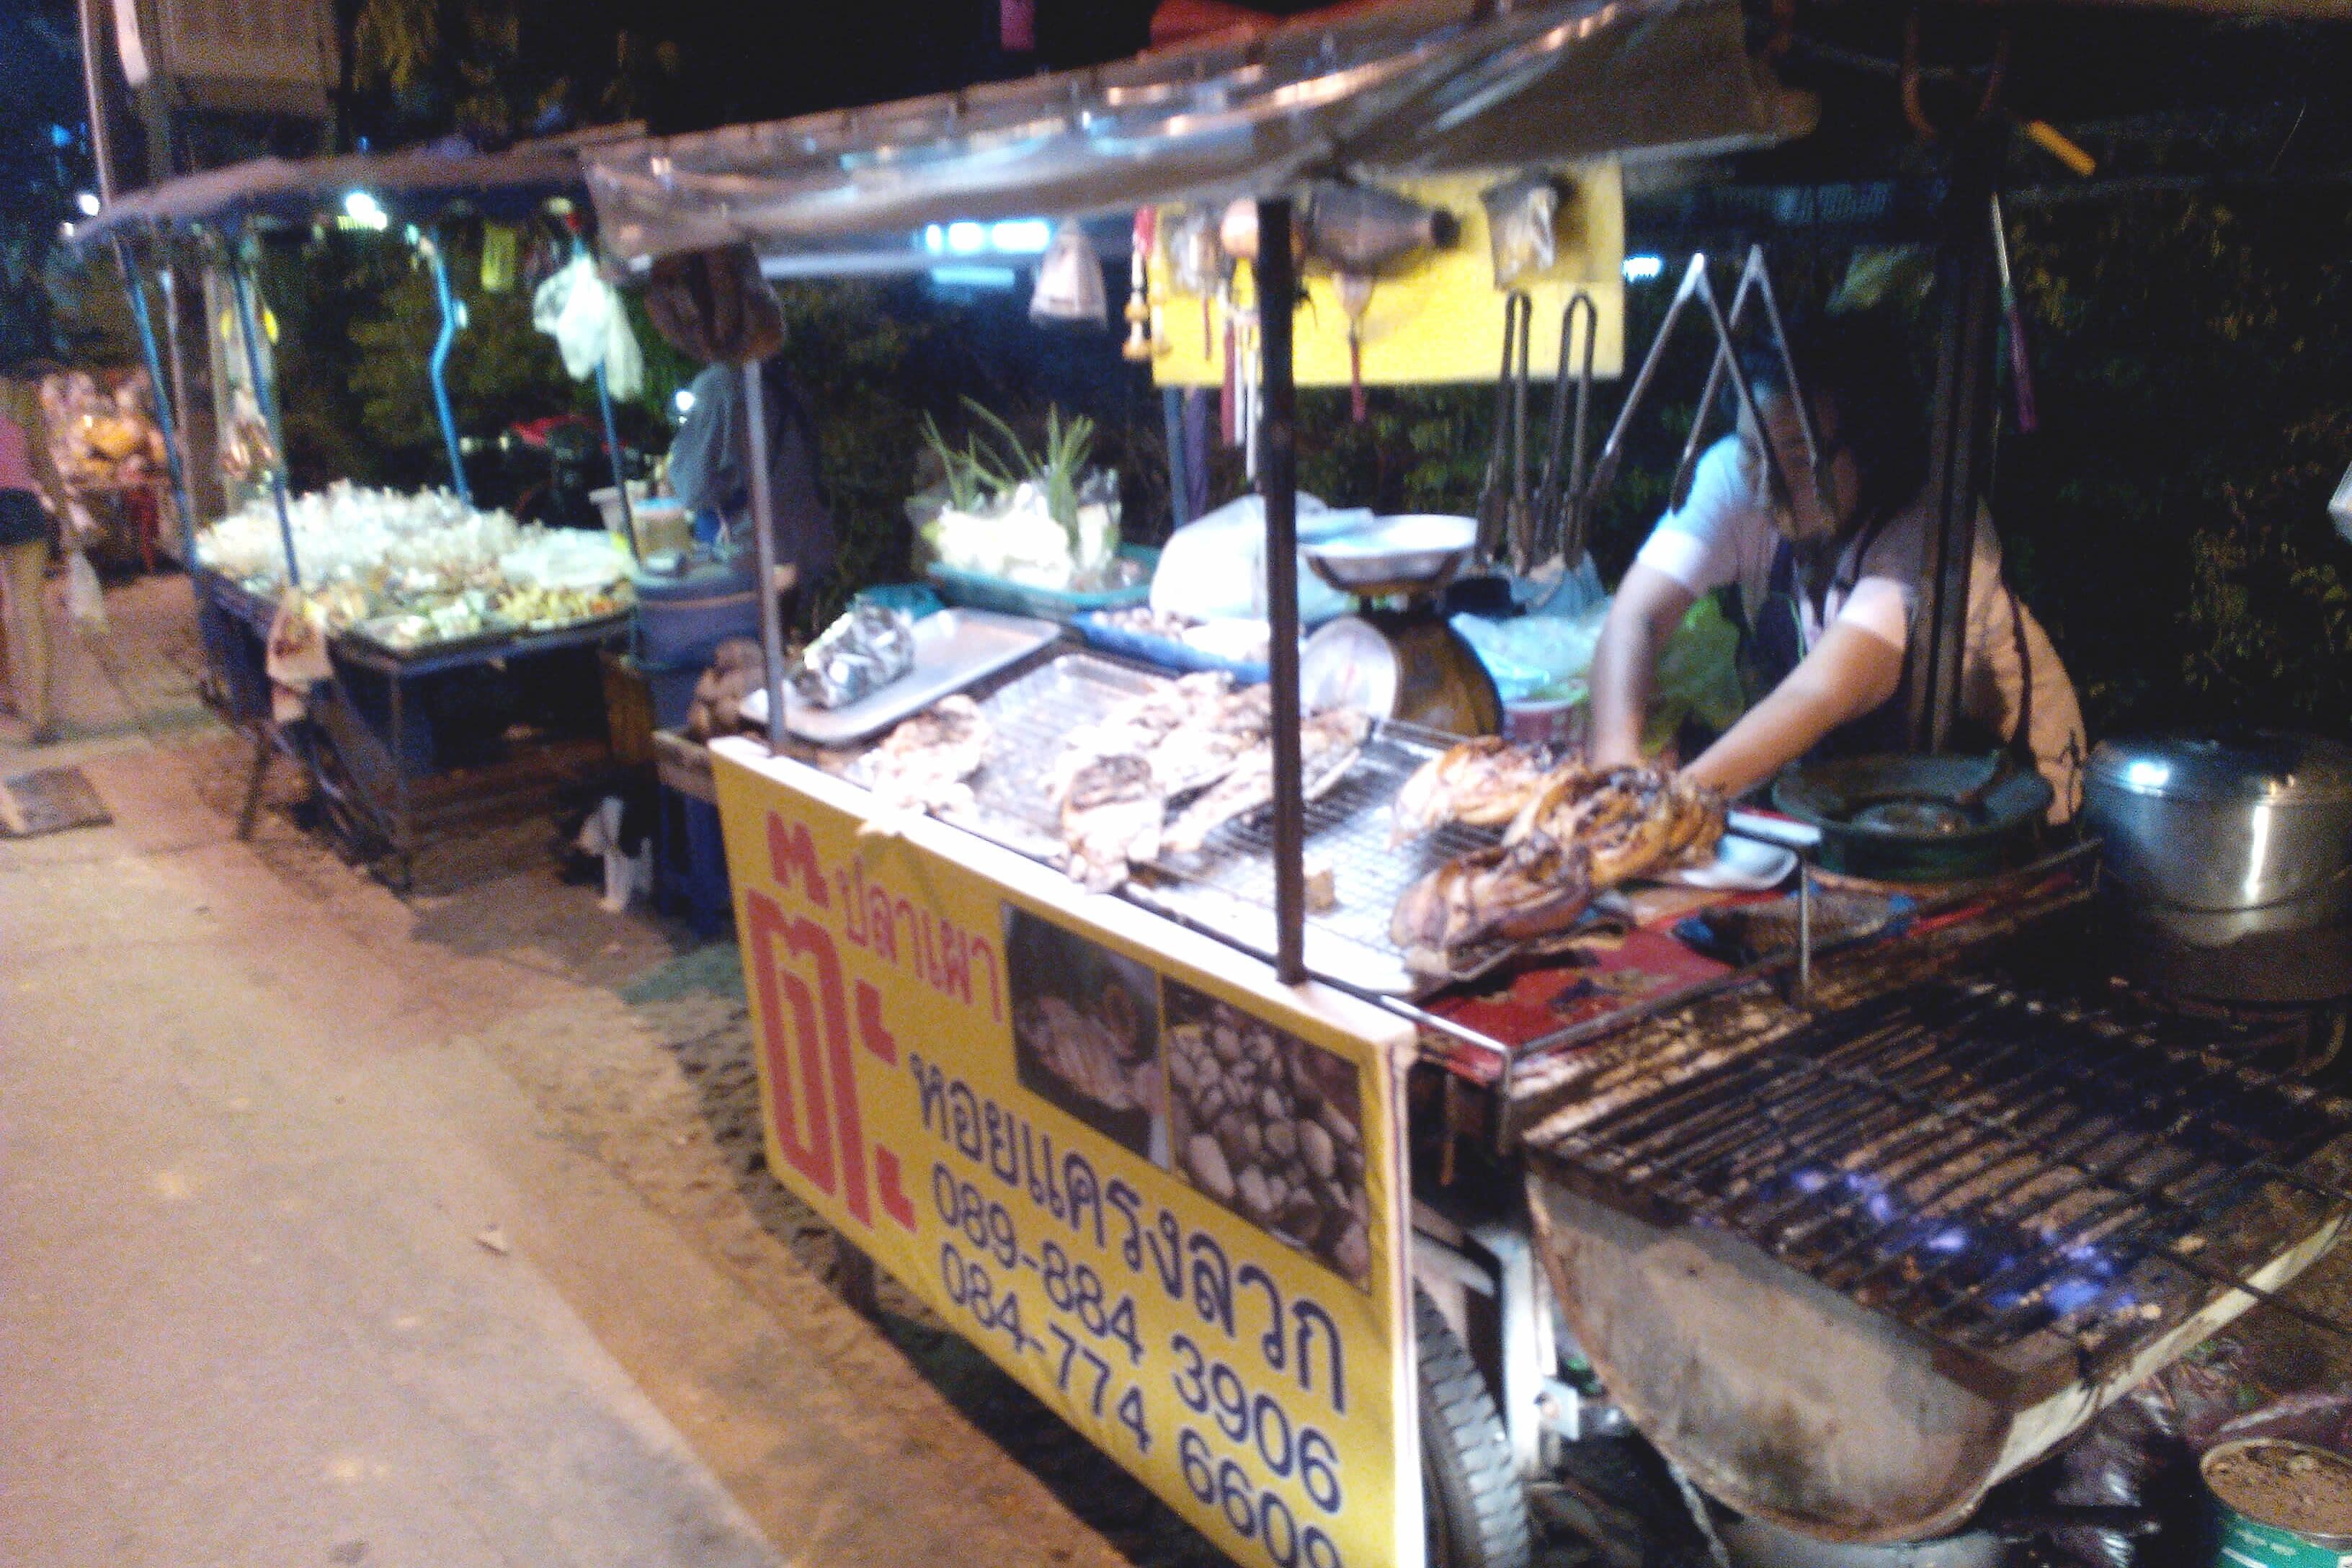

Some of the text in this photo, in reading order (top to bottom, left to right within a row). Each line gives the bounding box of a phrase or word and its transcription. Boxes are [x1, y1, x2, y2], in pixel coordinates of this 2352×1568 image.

[835, 854, 1002, 1023] ปลาเผา
[909, 1053, 1345, 1414] หอยแครงลวก
[933, 1162, 1340, 1514] 089-884 3906
[942, 1242, 1150, 1453] 084-774
